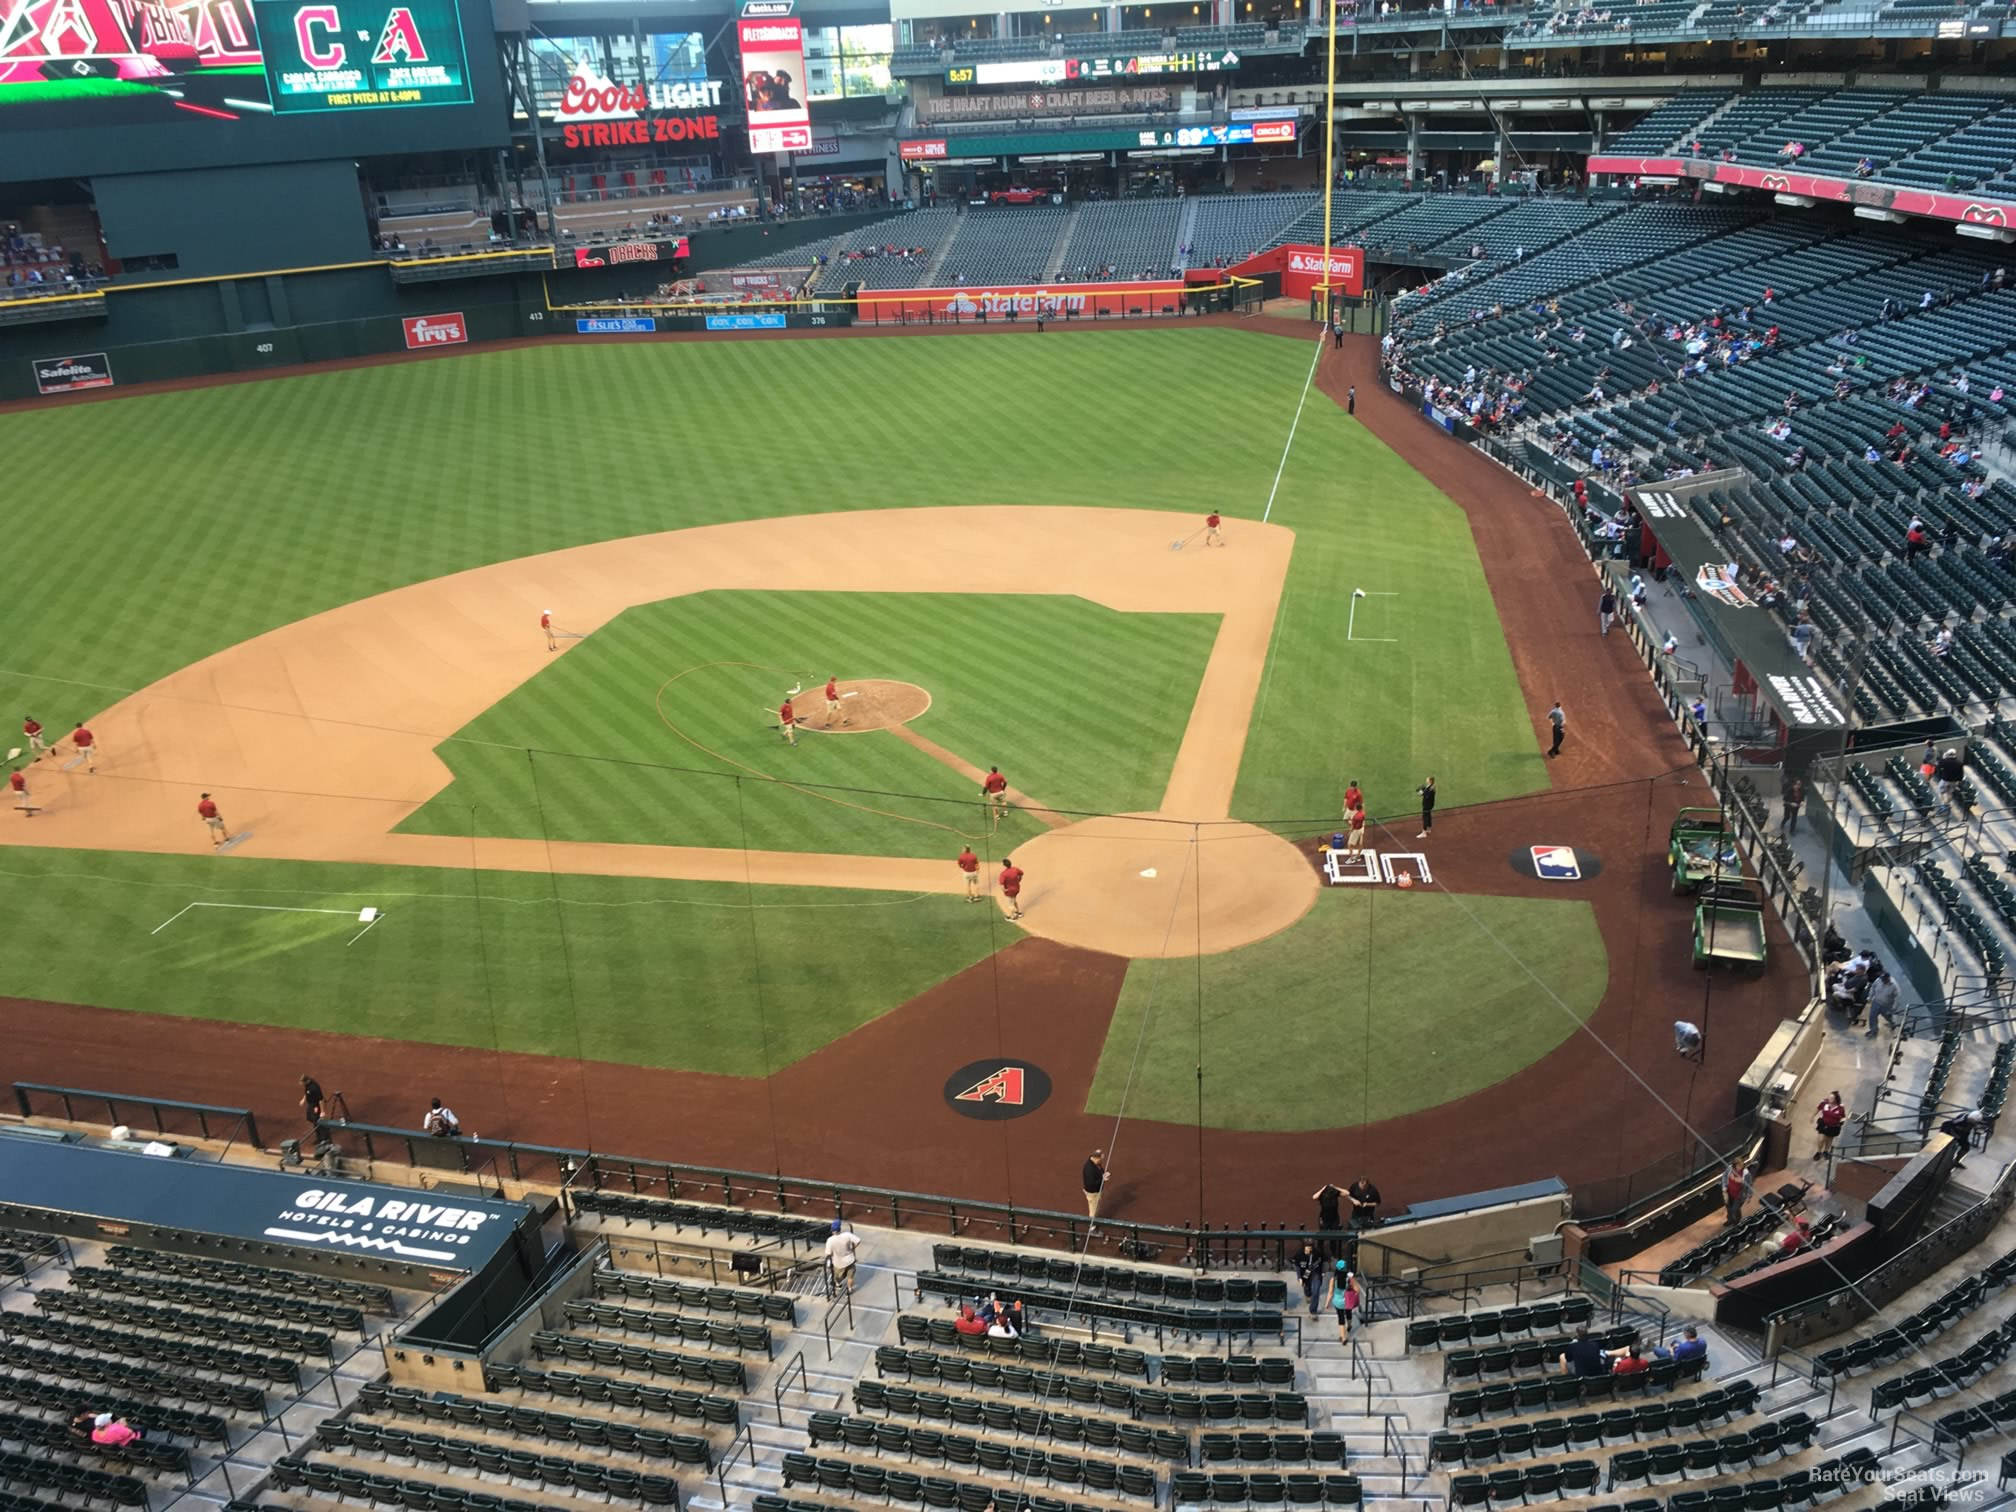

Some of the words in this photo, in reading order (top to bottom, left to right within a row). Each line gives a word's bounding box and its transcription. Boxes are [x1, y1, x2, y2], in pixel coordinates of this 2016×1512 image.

[1081, 63, 1089, 75] 6
[1115, 60, 1122, 72] 6
[1207, 61, 1220, 70] OUT
[949, 69, 973, 82] 5:57
[327, 92, 352, 106] FIRST
[353, 91, 379, 104] PITCH
[379, 91, 391, 102] AT
[560, 75, 648, 115] Coors
[649, 80, 722, 110] LIGHT
[929, 98, 951, 113] THE
[954, 96, 991, 112] DRAFT
[993, 94, 1027, 110] ROOM
[1046, 91, 1083, 107] CRAFT
[1086, 90, 1116, 105] BEER
[1119, 89, 1130, 103] &
[563, 119, 650, 149] STRIKE
[653, 115, 719, 142] ZONE
[529, 312, 544, 321] 413
[811, 317, 826, 325] 376
[411, 319, 461, 342] fry's
[256, 343, 273, 353] 407
[40, 365, 92, 378] Safelite
[295, 1189, 375, 1218] GILA
[375, 1199, 487, 1231] RIVER
[278, 1210, 356, 1230] HOTELS
[360, 1221, 374, 1231] &
[381, 1224, 471, 1245] CASINOS
